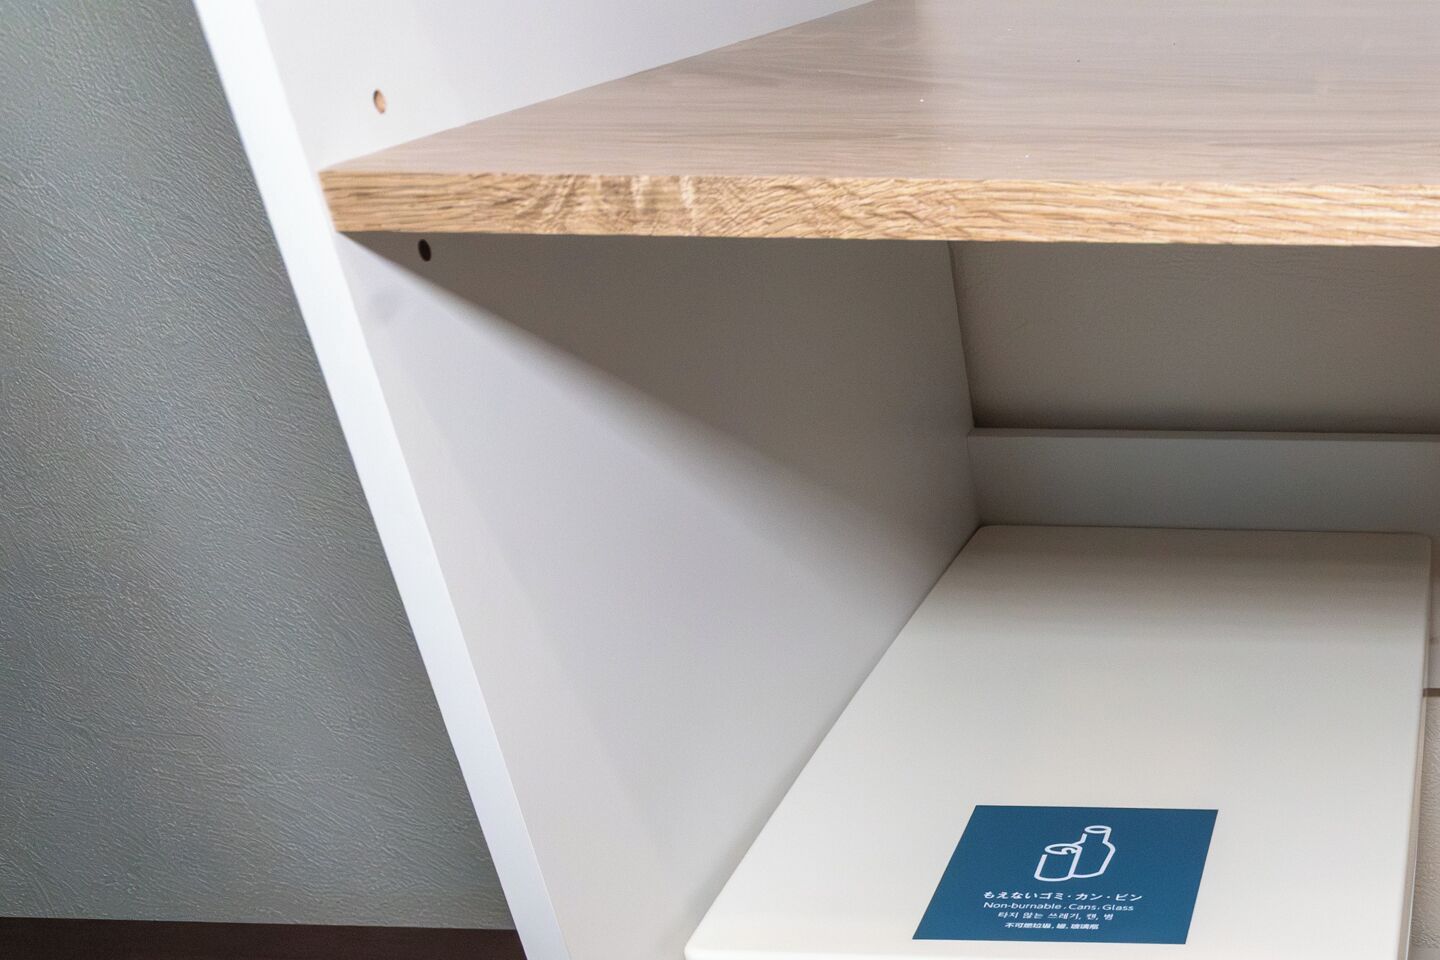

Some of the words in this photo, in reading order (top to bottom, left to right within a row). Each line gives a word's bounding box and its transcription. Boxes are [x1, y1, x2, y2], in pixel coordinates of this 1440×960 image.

[983, 891, 1143, 902] もえないゴミ・カン・ビン
[998, 911, 1019, 919] 타지
